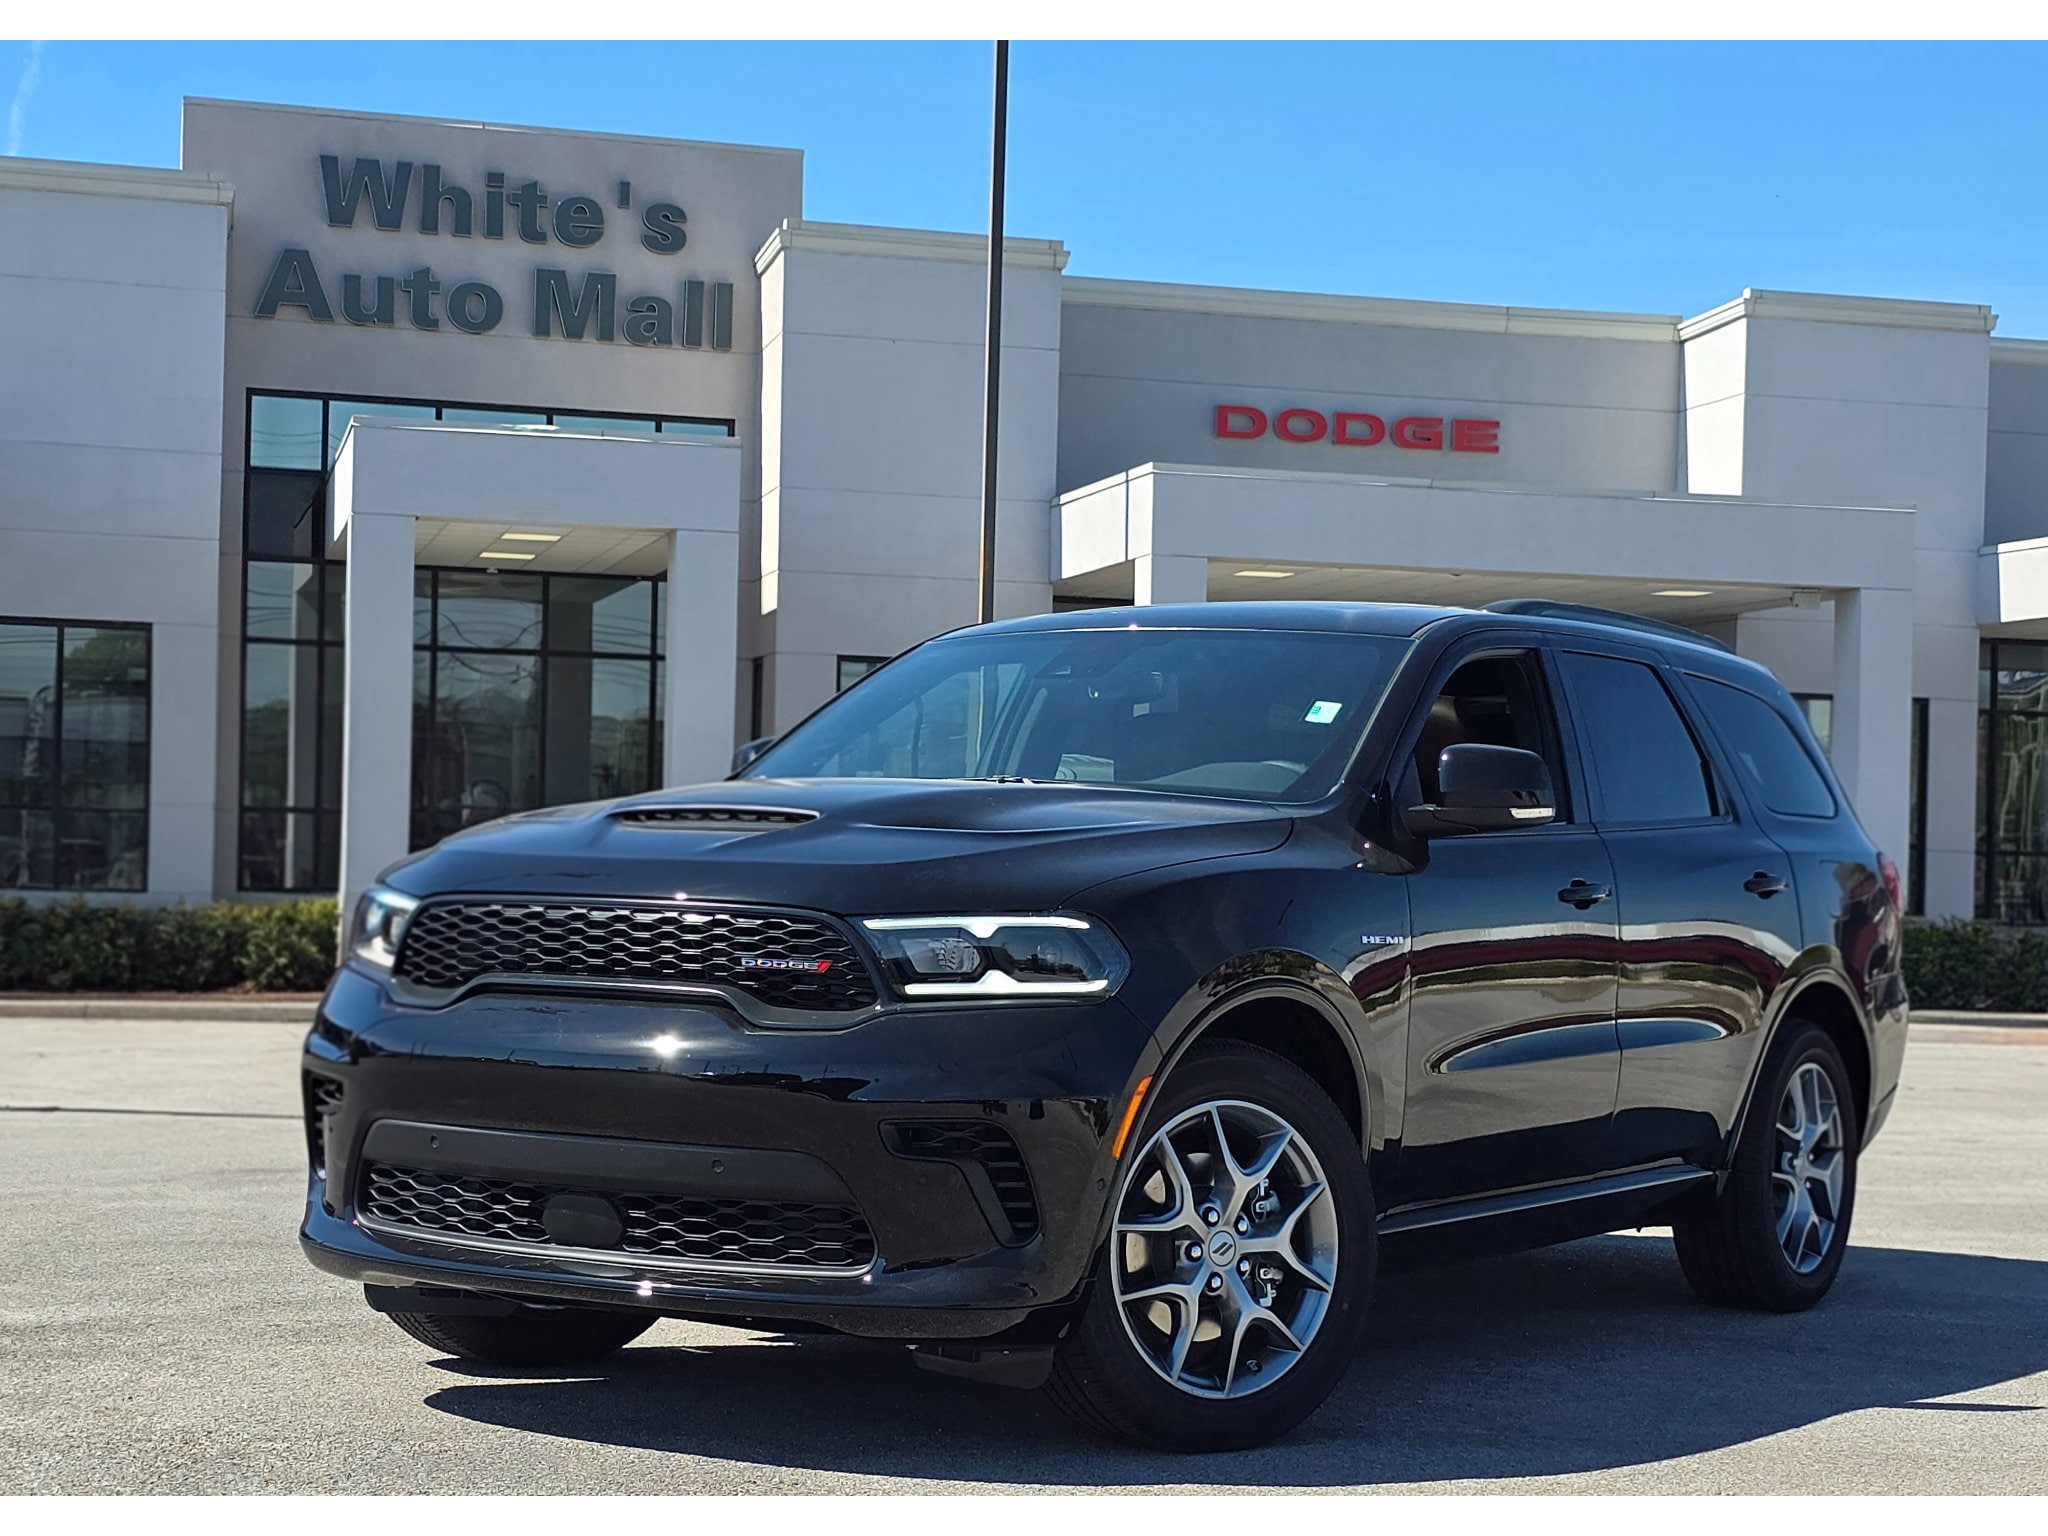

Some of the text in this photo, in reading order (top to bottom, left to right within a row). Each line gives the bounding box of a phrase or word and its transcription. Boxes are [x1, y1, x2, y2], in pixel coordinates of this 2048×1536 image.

[319, 154, 687, 255] White's
[253, 247, 734, 351] Auto Mall
[1213, 404, 1501, 454] DODGE
[741, 958, 819, 970] DODGE
[1361, 935, 1403, 944] HEMI
